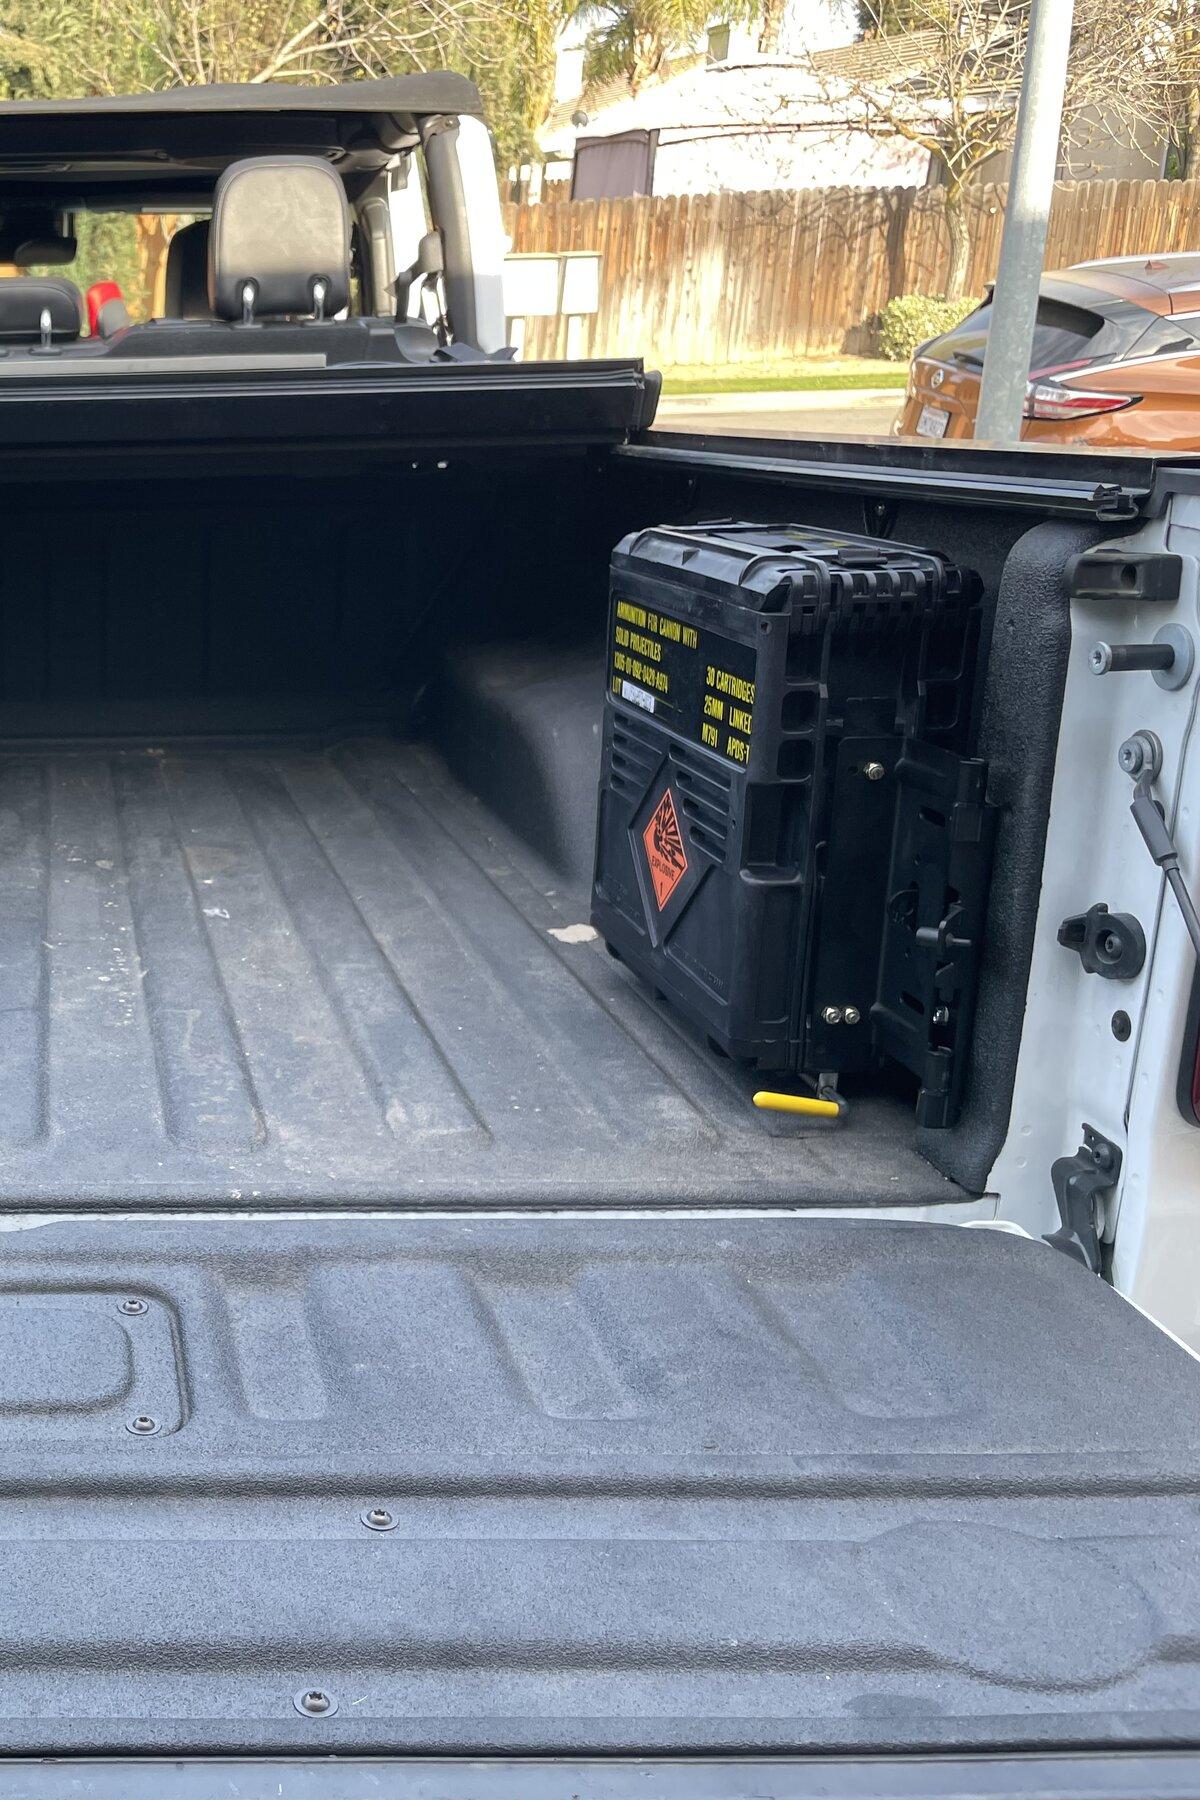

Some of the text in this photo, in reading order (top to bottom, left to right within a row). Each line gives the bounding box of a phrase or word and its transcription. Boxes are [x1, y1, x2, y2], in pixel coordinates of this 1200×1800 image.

[615, 625, 662, 663] SOLID PROJECTILES
[647, 612, 658, 634] FOR
[659, 617, 681, 643] CANNON
[682, 625, 698, 650] WITH
[612, 675, 622, 696] LOT
[705, 665, 756, 705] 30 CARTRIDGES
[703, 694, 724, 721] 25MM
[701, 722, 719, 749] M791
[651, 855, 675, 881] EXPLOSIVE
